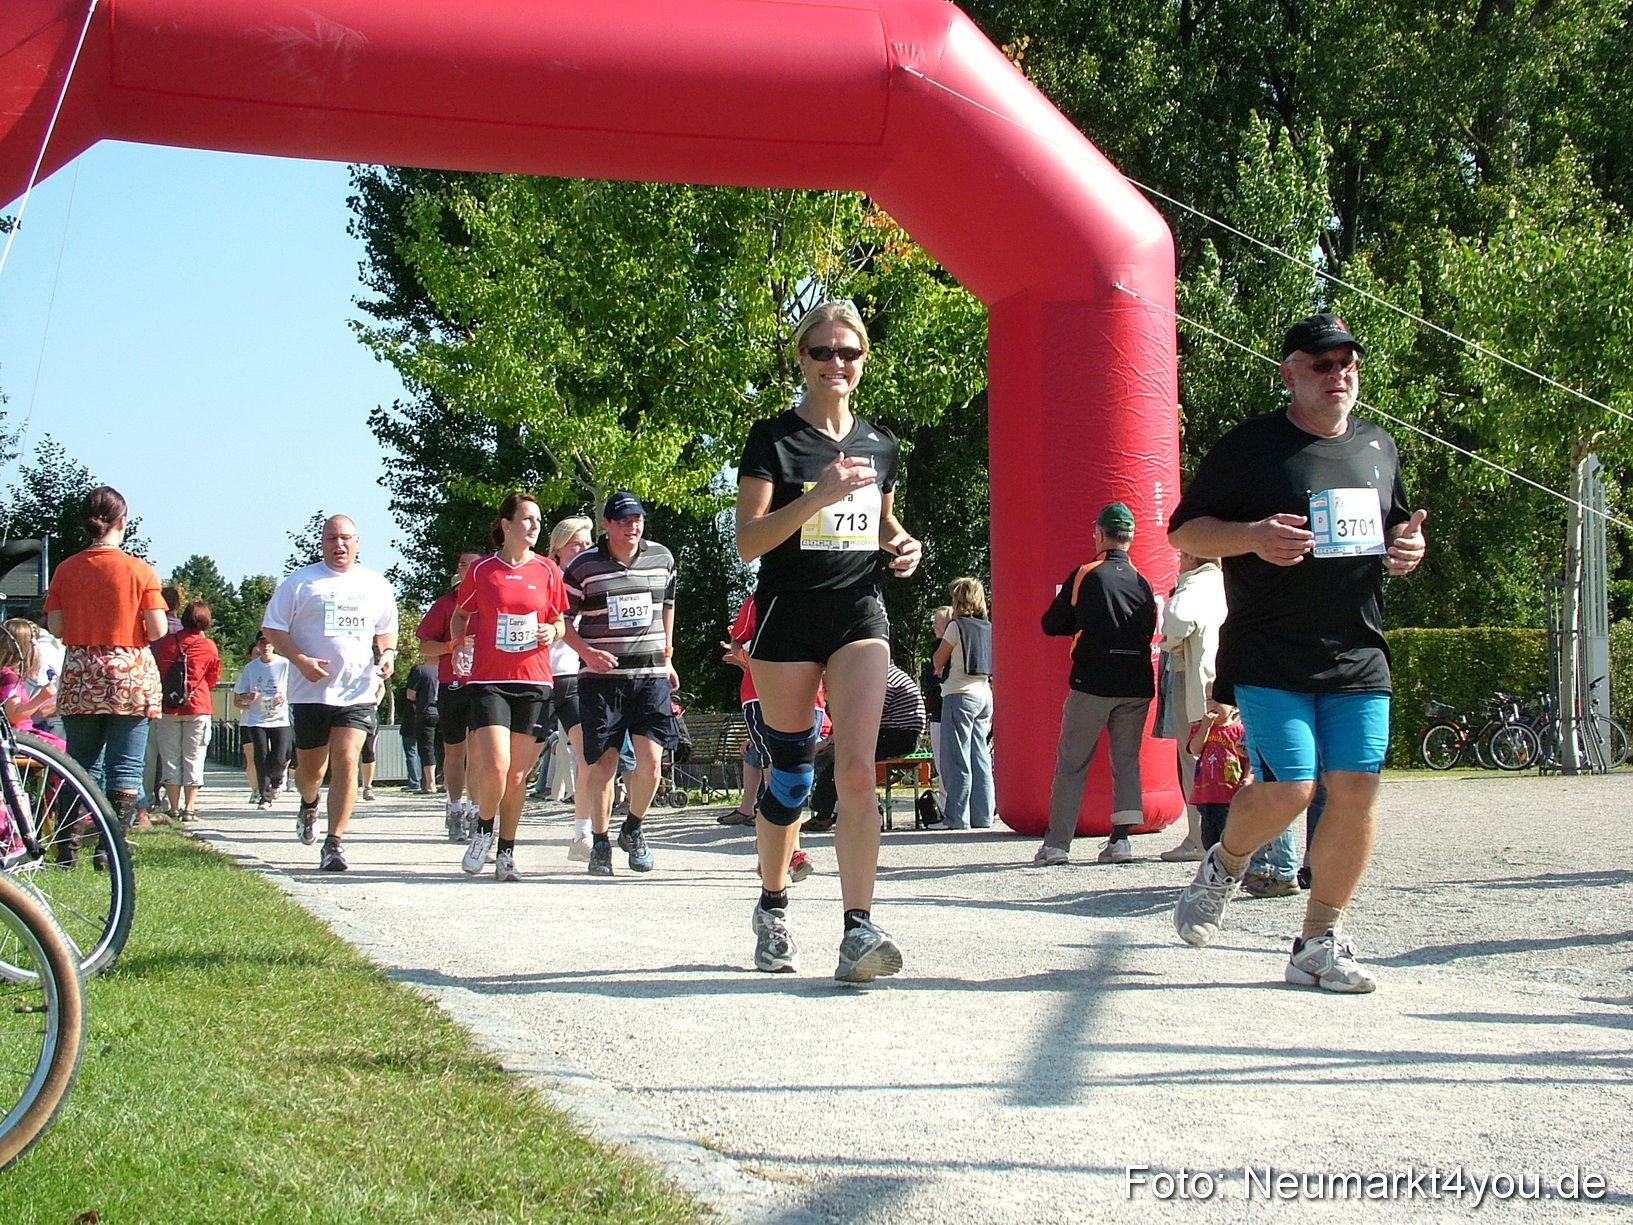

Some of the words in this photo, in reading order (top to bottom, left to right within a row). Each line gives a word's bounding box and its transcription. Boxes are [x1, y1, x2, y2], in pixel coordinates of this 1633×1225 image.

[834, 513, 868, 531] 713
[1337, 518, 1376, 537] 3701
[337, 604, 359, 612] Michael
[621, 605, 649, 618] 2937
[338, 616, 365, 627] 2901
